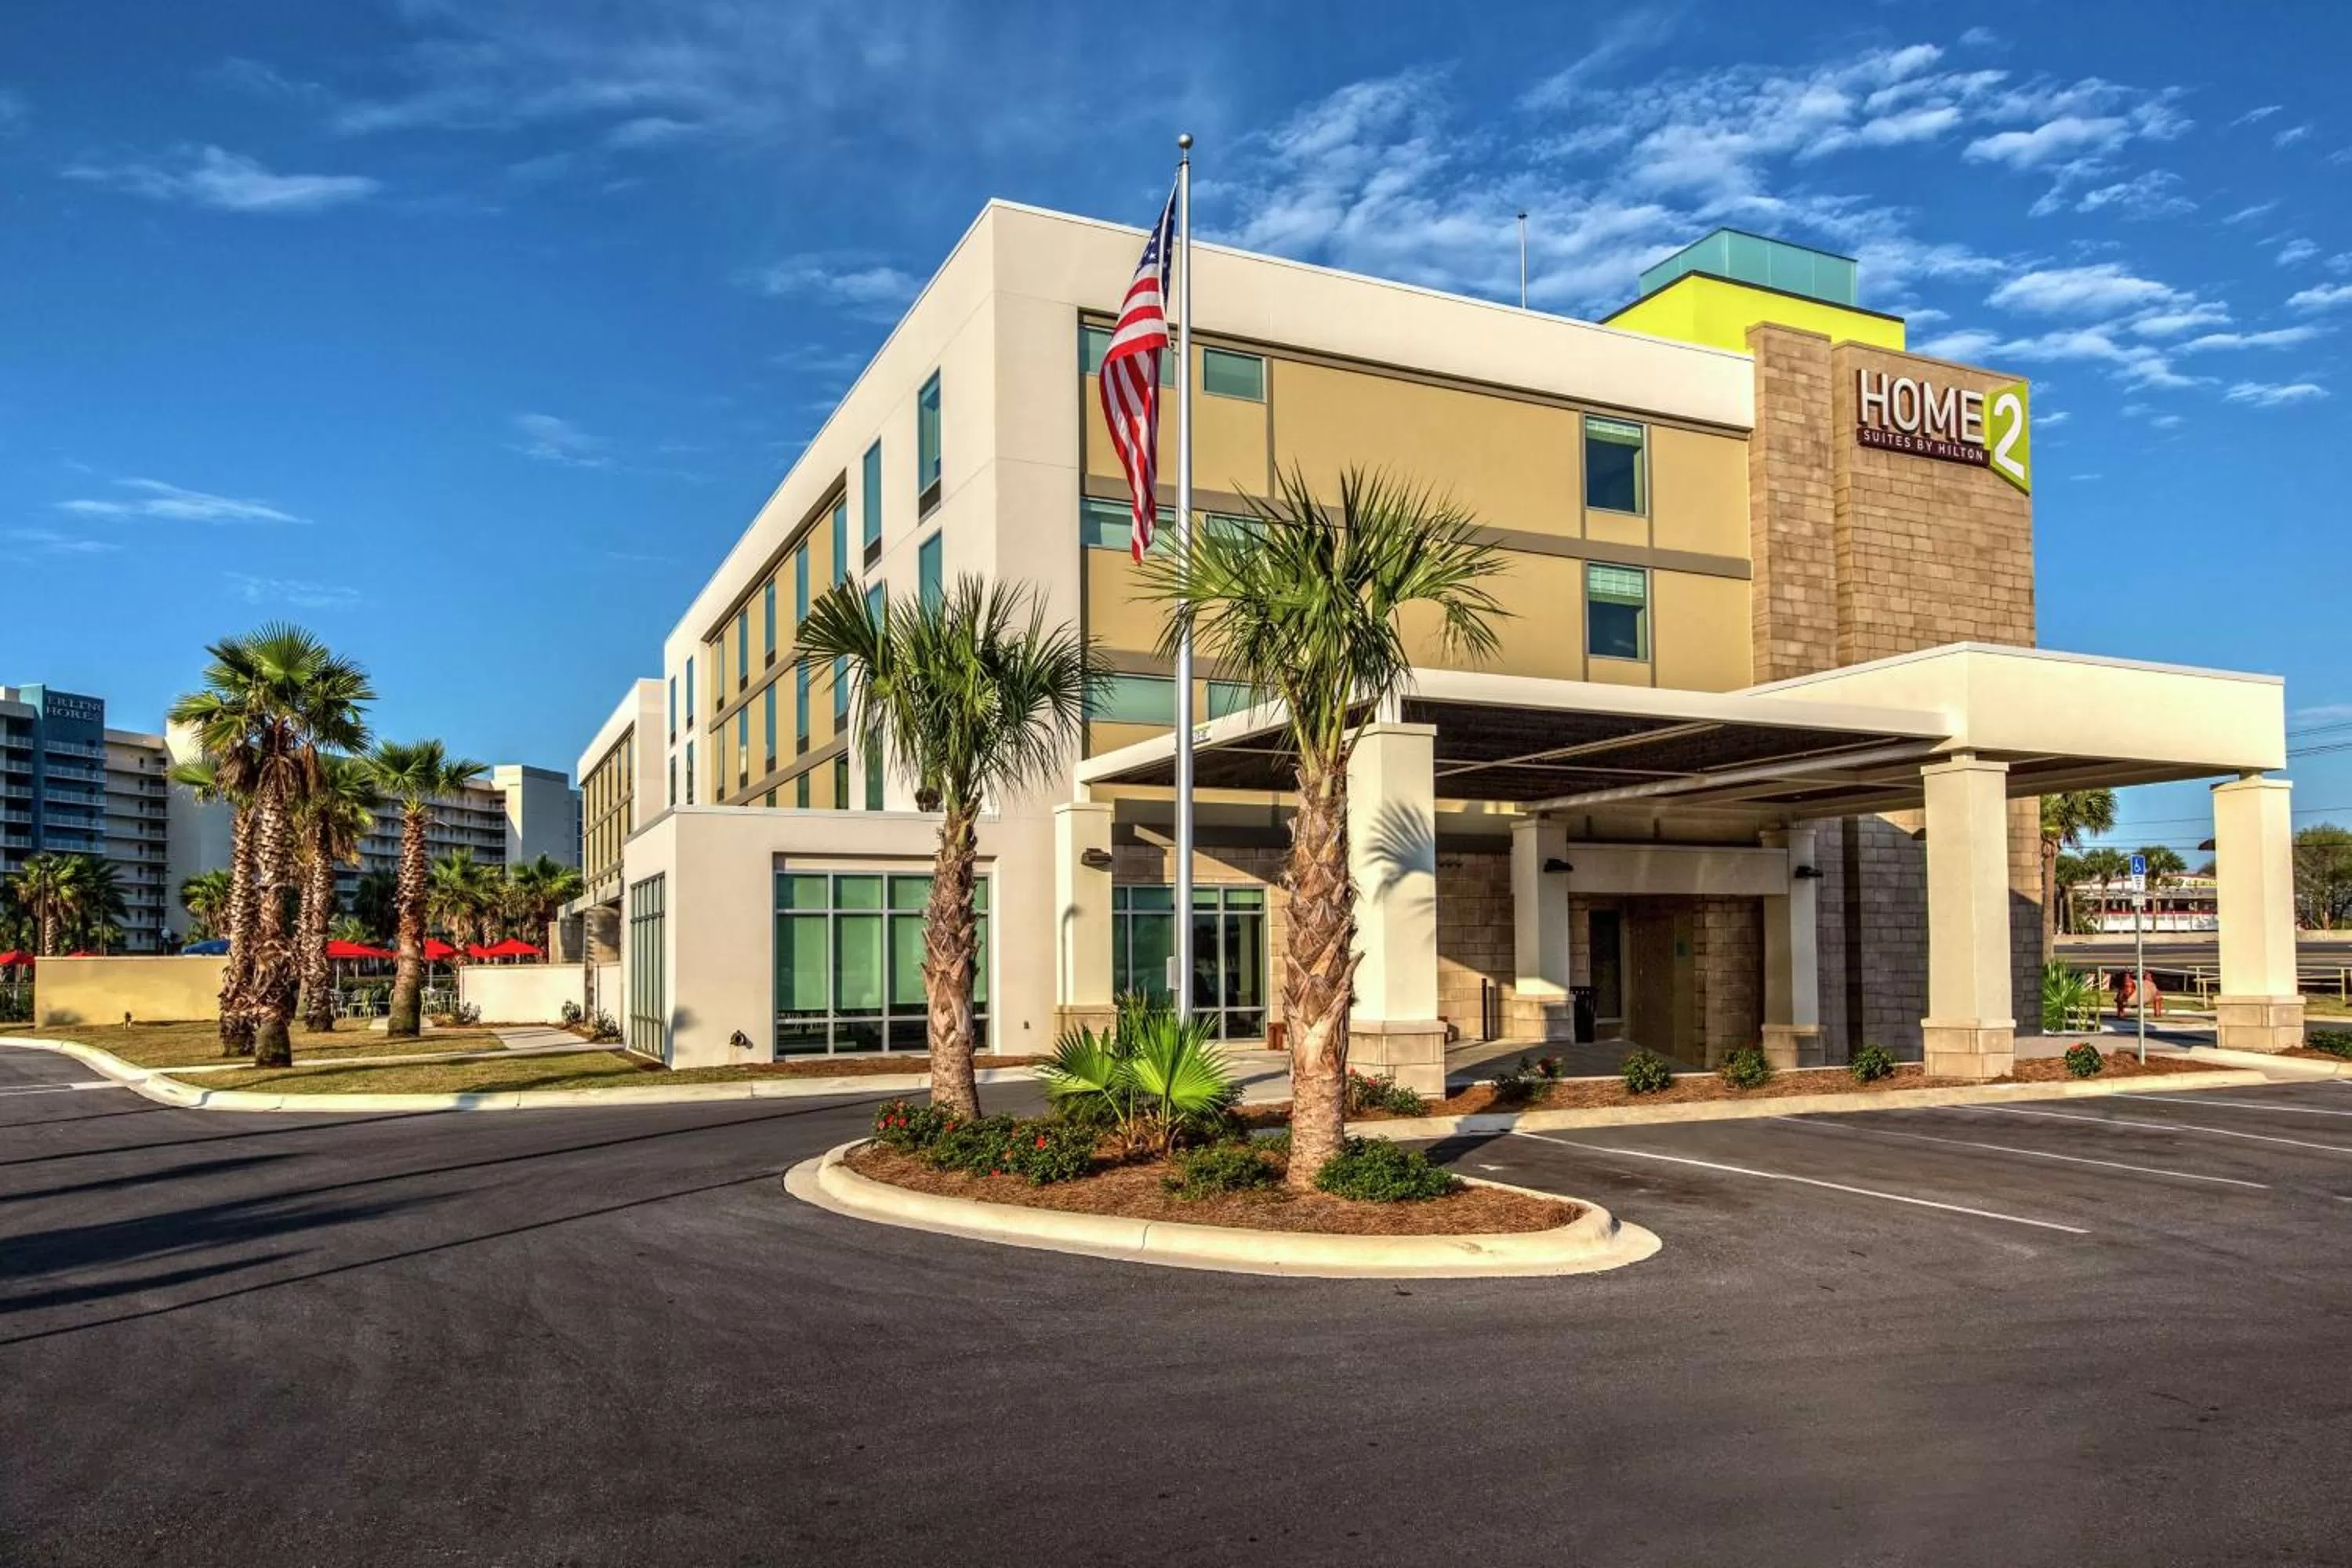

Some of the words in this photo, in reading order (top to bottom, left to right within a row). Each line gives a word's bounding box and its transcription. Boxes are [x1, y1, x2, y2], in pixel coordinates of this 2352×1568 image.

[1859, 368, 1984, 445] HOME
[1994, 393, 2025, 481] 2
[1863, 429, 1911, 448] SUITES
[1917, 438, 1933, 452] BY
[1938, 442, 1984, 462] HILTON
